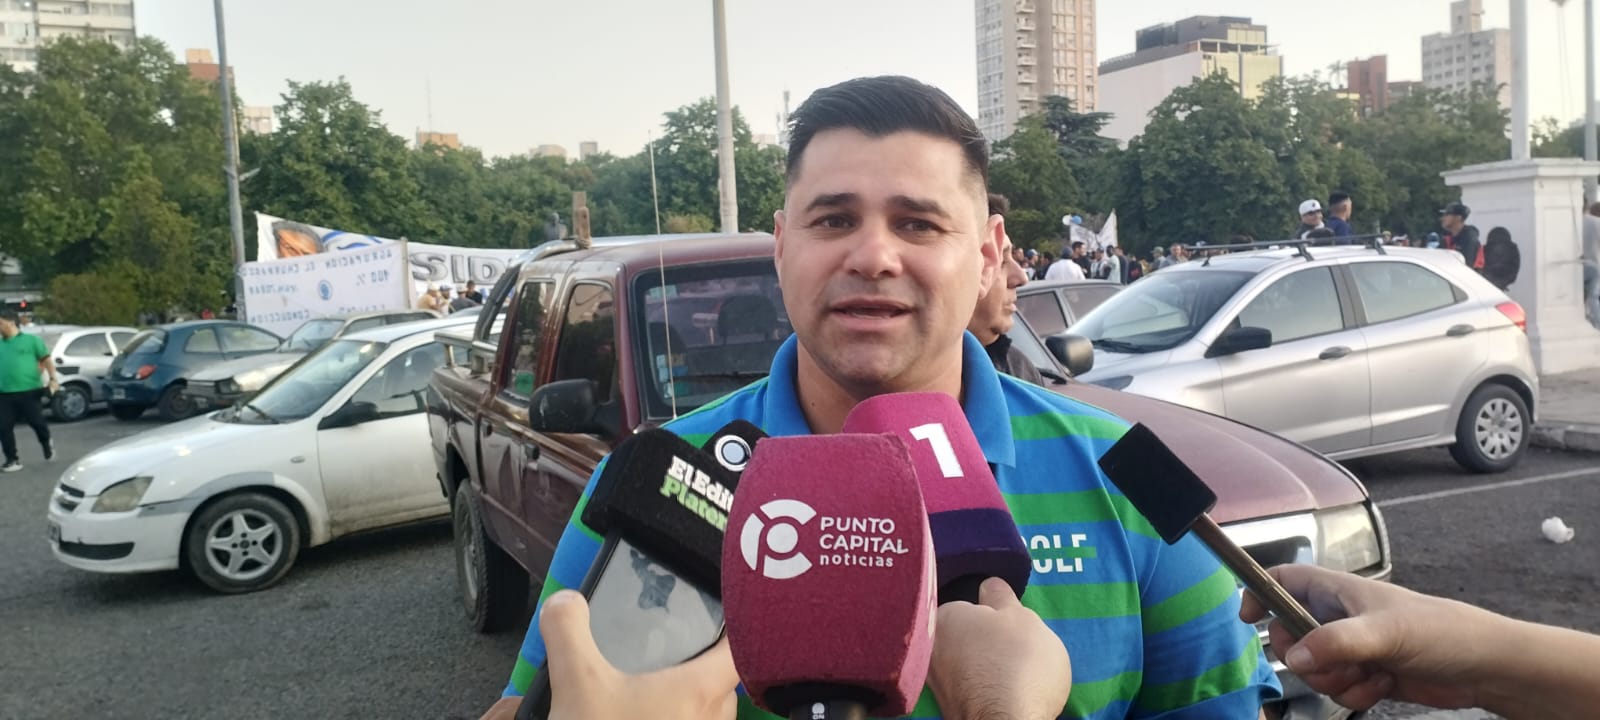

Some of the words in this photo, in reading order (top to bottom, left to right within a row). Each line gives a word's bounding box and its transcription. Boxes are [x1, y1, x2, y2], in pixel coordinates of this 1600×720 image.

[408, 252, 512, 285] SID
[909, 423, 964, 478] 1
[820, 516, 896, 535] PUNTO
[819, 534, 909, 555] CAPITAL
[1020, 533, 1087, 575] OLF
[820, 554, 894, 568] noticias
